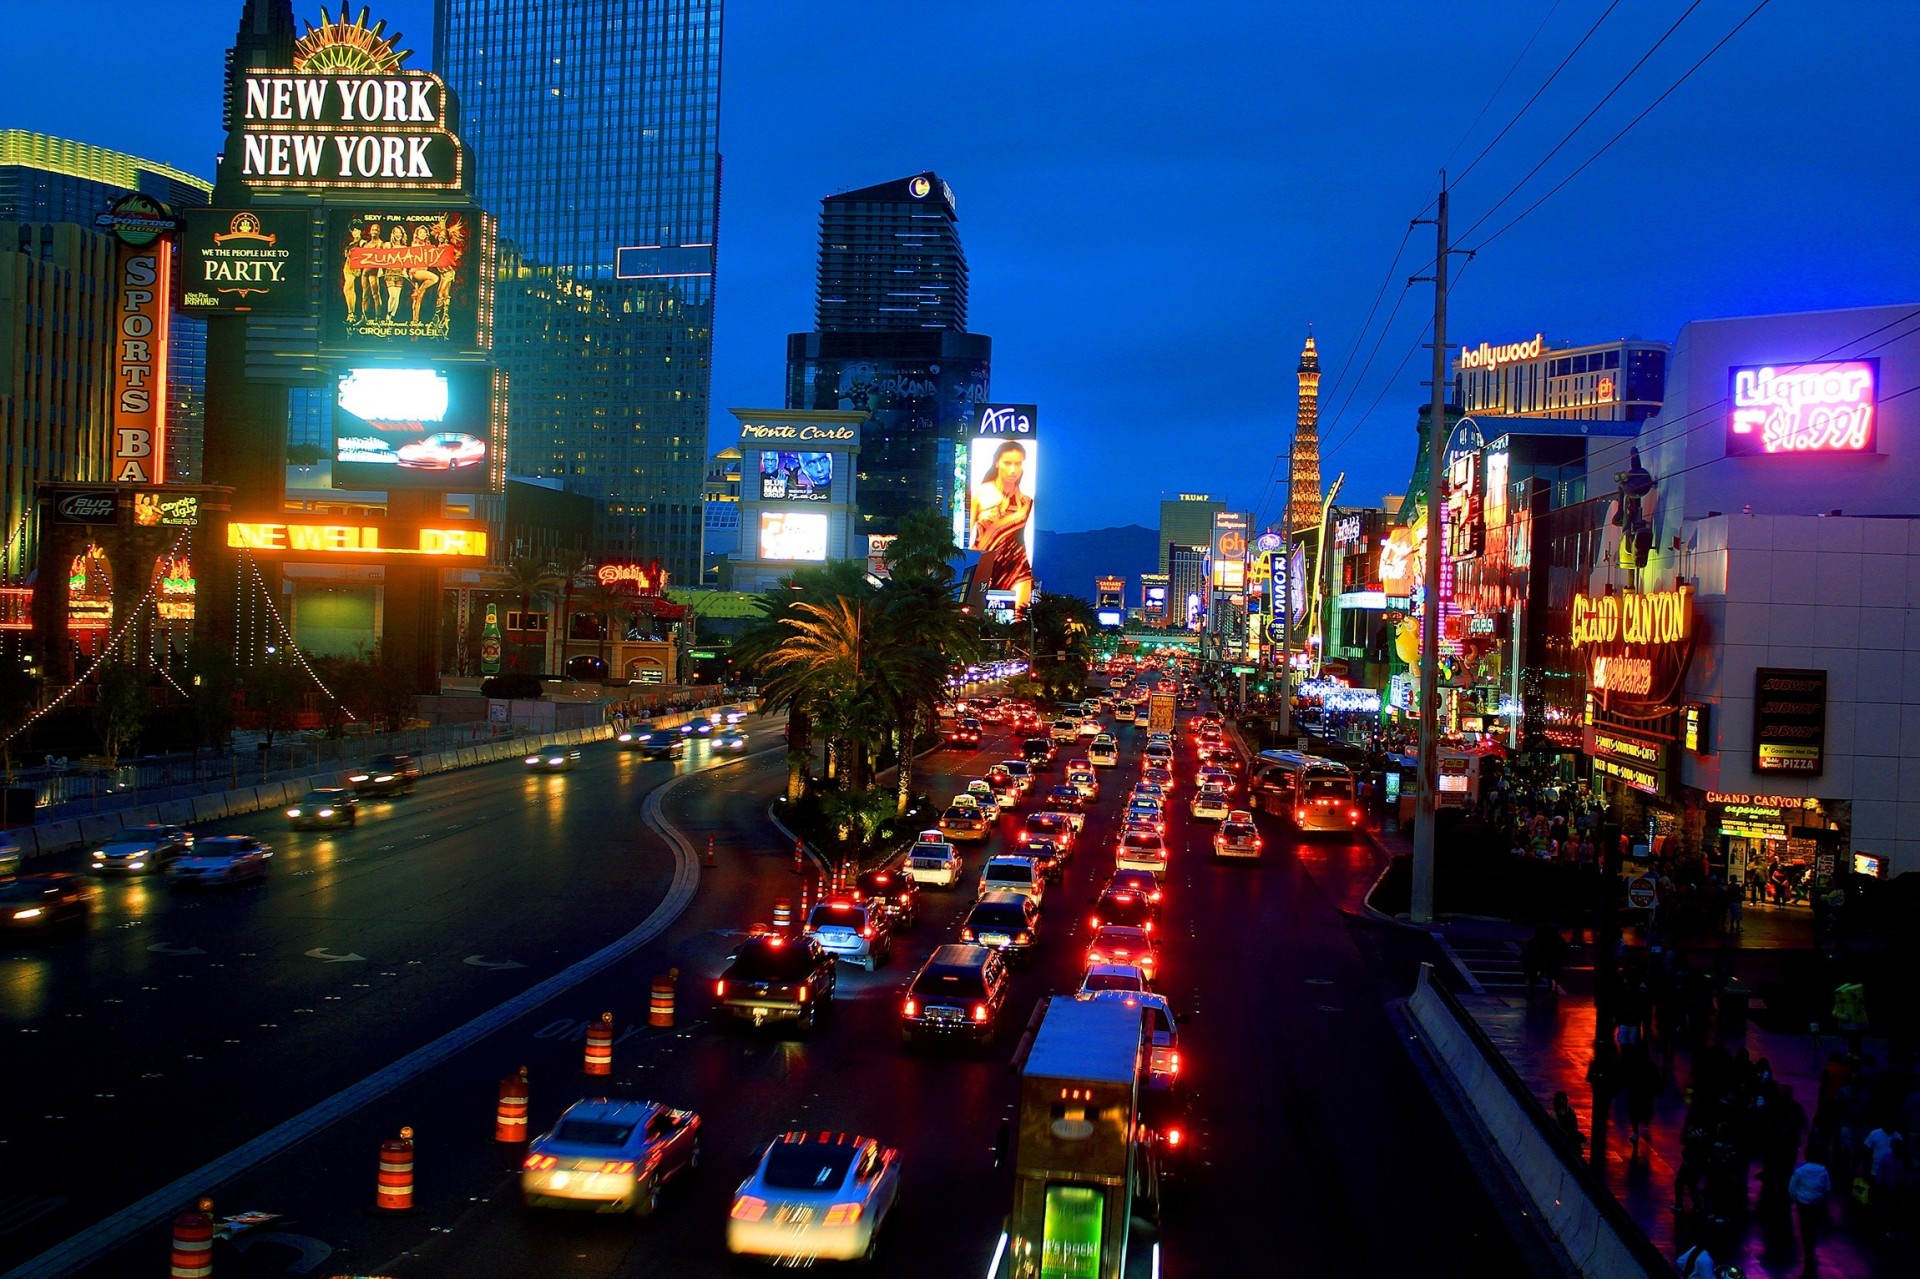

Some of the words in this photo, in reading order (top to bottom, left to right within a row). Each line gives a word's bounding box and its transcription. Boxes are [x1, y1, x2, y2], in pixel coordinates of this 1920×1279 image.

[245, 78, 329, 120] NEW
[336, 79, 436, 122] YORK
[242, 134, 327, 177] NEW
[334, 135, 433, 178] YORK
[201, 249, 214, 257] WE
[215, 249, 230, 257] THE
[231, 249, 259, 258] PEOPLE
[260, 249, 277, 258] LIKE
[277, 250, 289, 258] TO
[360, 248, 446, 266] ZUMANITY
[204, 260, 286, 282] PARTY.
[121, 256, 156, 413] SPORTS
[359, 327, 392, 338] CIRQUE
[394, 328, 407, 336] DU
[408, 328, 440, 337] SOLEIL
[1461, 333, 1543, 372] hollywood
[1735, 366, 1871, 412] Liquor
[979, 407, 1031, 435] Aria
[1763, 402, 1874, 453] $1.99!
[741, 424, 798, 438] Monte
[799, 426, 855, 440] Carlo
[66, 506, 115, 516] LIGHT
[74, 498, 114, 508] BUD
[160, 496, 196, 513] coyote
[171, 505, 198, 518] ugly
[1274, 557, 1287, 613] ROSS
[987, 600, 1006, 609] Aria
[1572, 593, 1619, 648] GRAND
[1622, 585, 1687, 645] CANYON
[1594, 648, 1651, 708] experience
[1762, 679, 1817, 691] SUBWAY
[1762, 702, 1818, 714] SUBWAY
[1761, 725, 1817, 737] SUBWAY
[1783, 759, 1814, 769] PIZZA
[1706, 791, 1750, 804] GRAND
[1753, 795, 1802, 808] CANYON
[1724, 805, 1780, 816] experience
[533, 1018, 648, 1045] ONY
